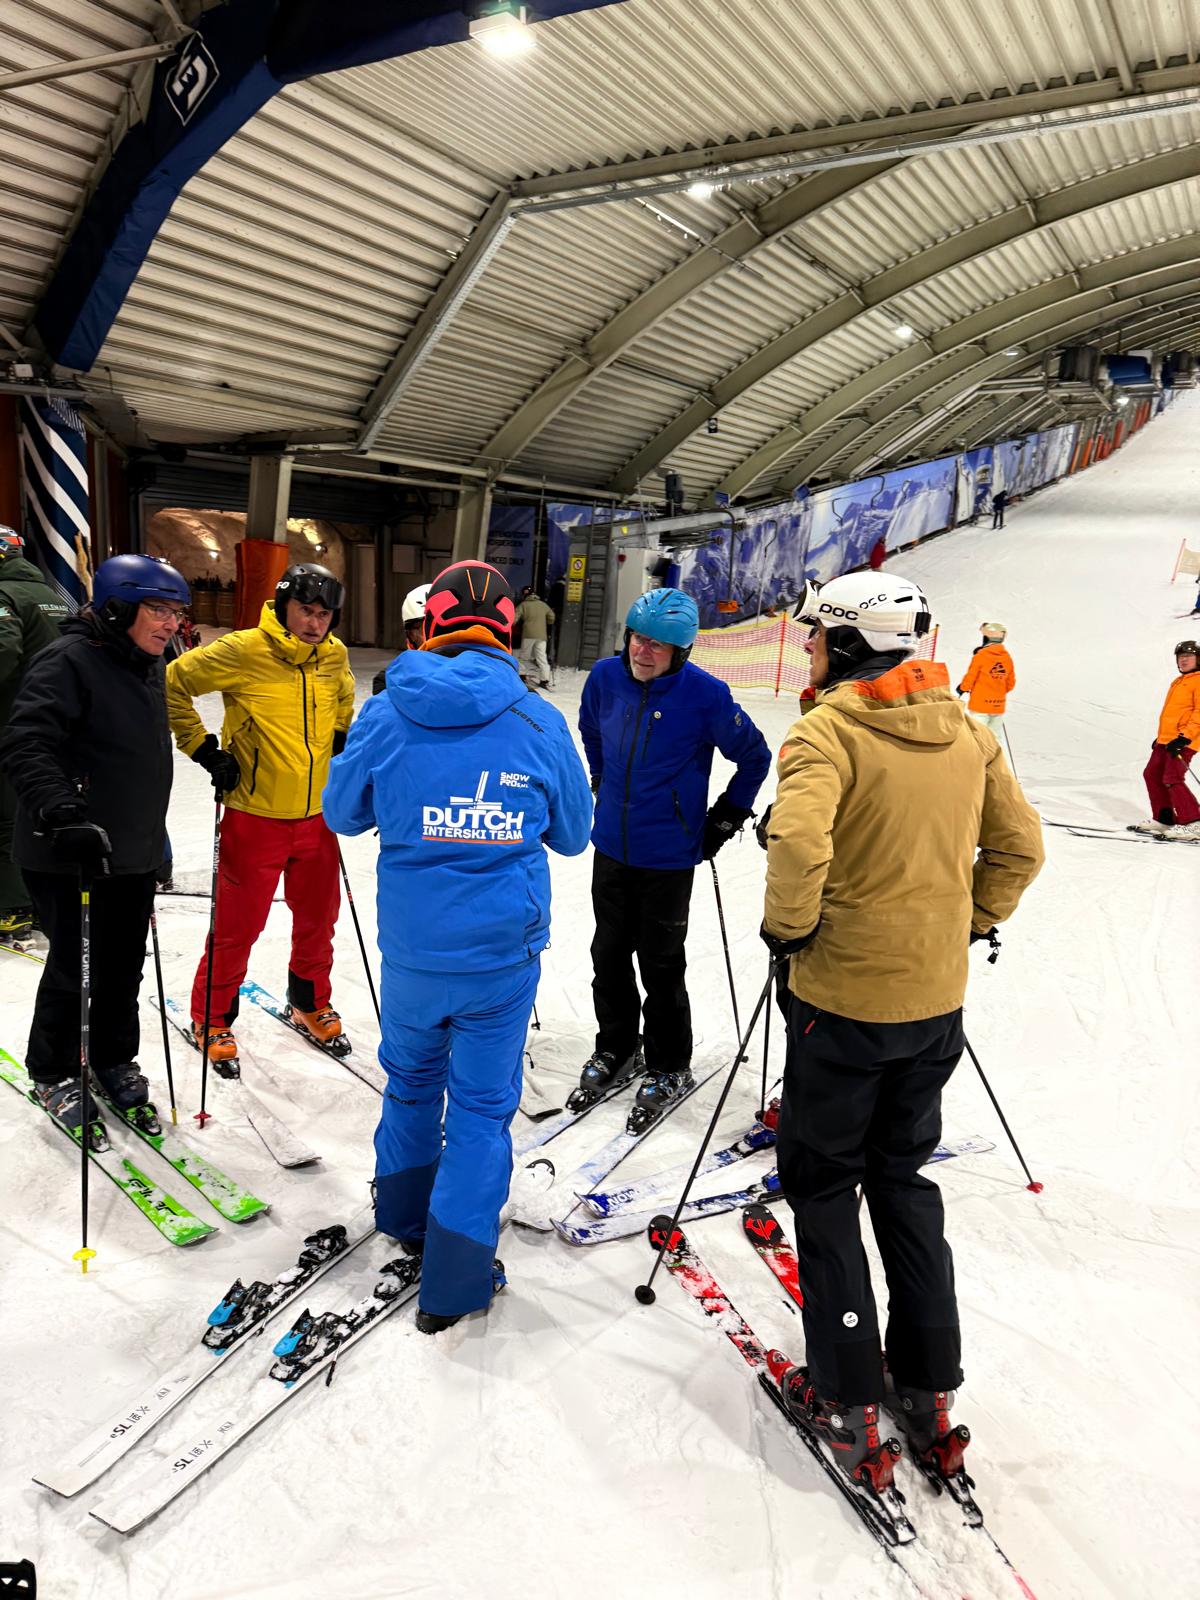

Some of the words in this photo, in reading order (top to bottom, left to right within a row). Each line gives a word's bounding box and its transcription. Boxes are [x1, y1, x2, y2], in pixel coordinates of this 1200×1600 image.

[818, 603, 859, 621] POC
[500, 771, 530, 783] SNOW
[423, 805, 525, 831] DUTCH
[423, 825, 487, 840] INTERSKI
[489, 829, 523, 841] TEAM
[82, 937, 90, 989] ATOMIC
